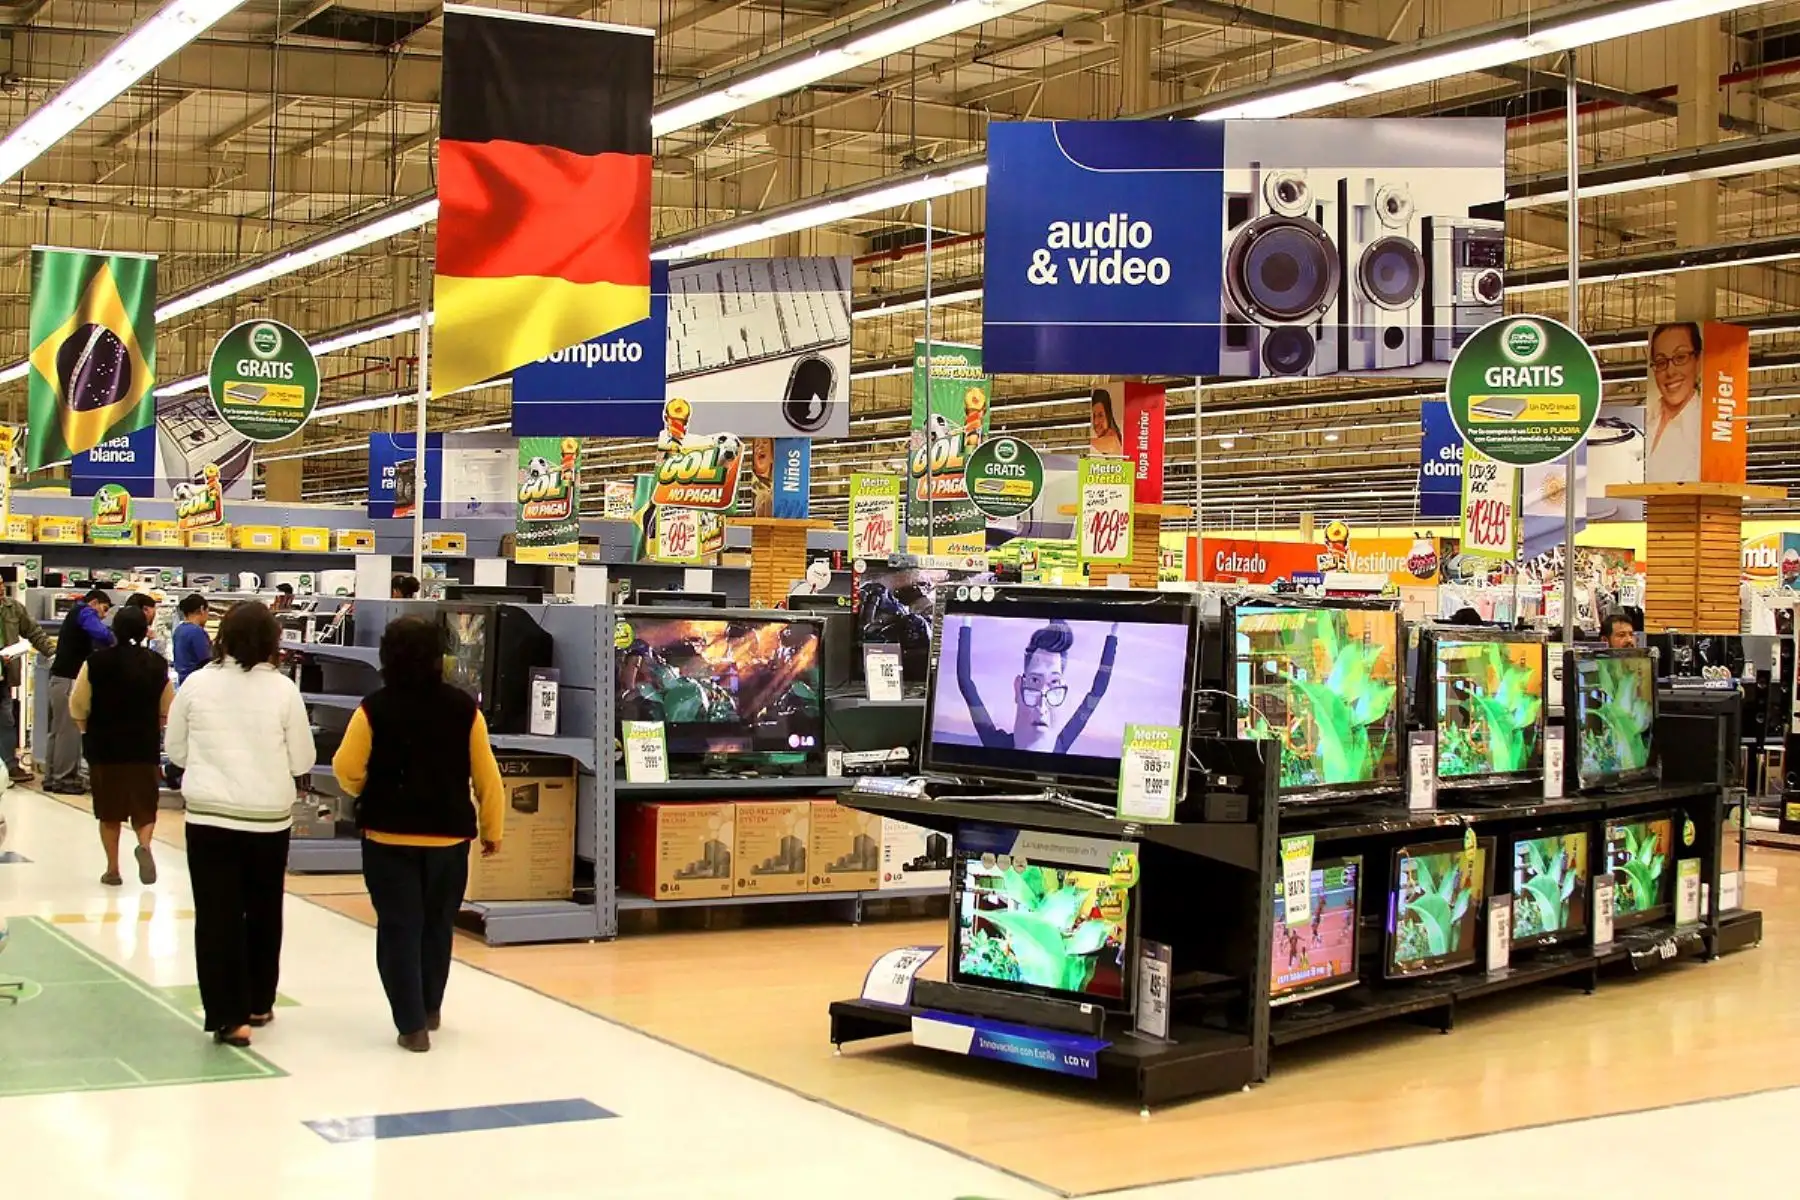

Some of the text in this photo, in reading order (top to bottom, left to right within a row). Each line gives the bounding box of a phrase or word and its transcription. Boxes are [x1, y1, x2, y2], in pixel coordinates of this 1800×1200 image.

[1047, 213, 1152, 249] audio
[1027, 249, 1171, 285] & video
[236, 359, 294, 380] GRATIS
[1485, 366, 1563, 388] GRATIS
[1712, 370, 1736, 442] Mujer
[89, 447, 135, 462] blanca
[659, 448, 718, 482] GOL
[782, 449, 801, 493] Niños
[985, 463, 1026, 476] GRATIS
[1089, 463, 1122, 475] Metro
[1136, 452, 1150, 480] Ropa
[519, 471, 563, 502] GOL
[1086, 471, 1127, 484] Oferta!
[667, 487, 724, 503] NO PAGA!
[1215, 551, 1267, 573] Calzado
[1348, 551, 1409, 573] Vestidore
[1130, 739, 1173, 751] Oferta!
[1135, 729, 1169, 741] Metro
[893, 873, 903, 881] LG
[1020, 1046, 1033, 1057] con
[1064, 1054, 1079, 1066] LCD
[1080, 1056, 1090, 1069] TV
